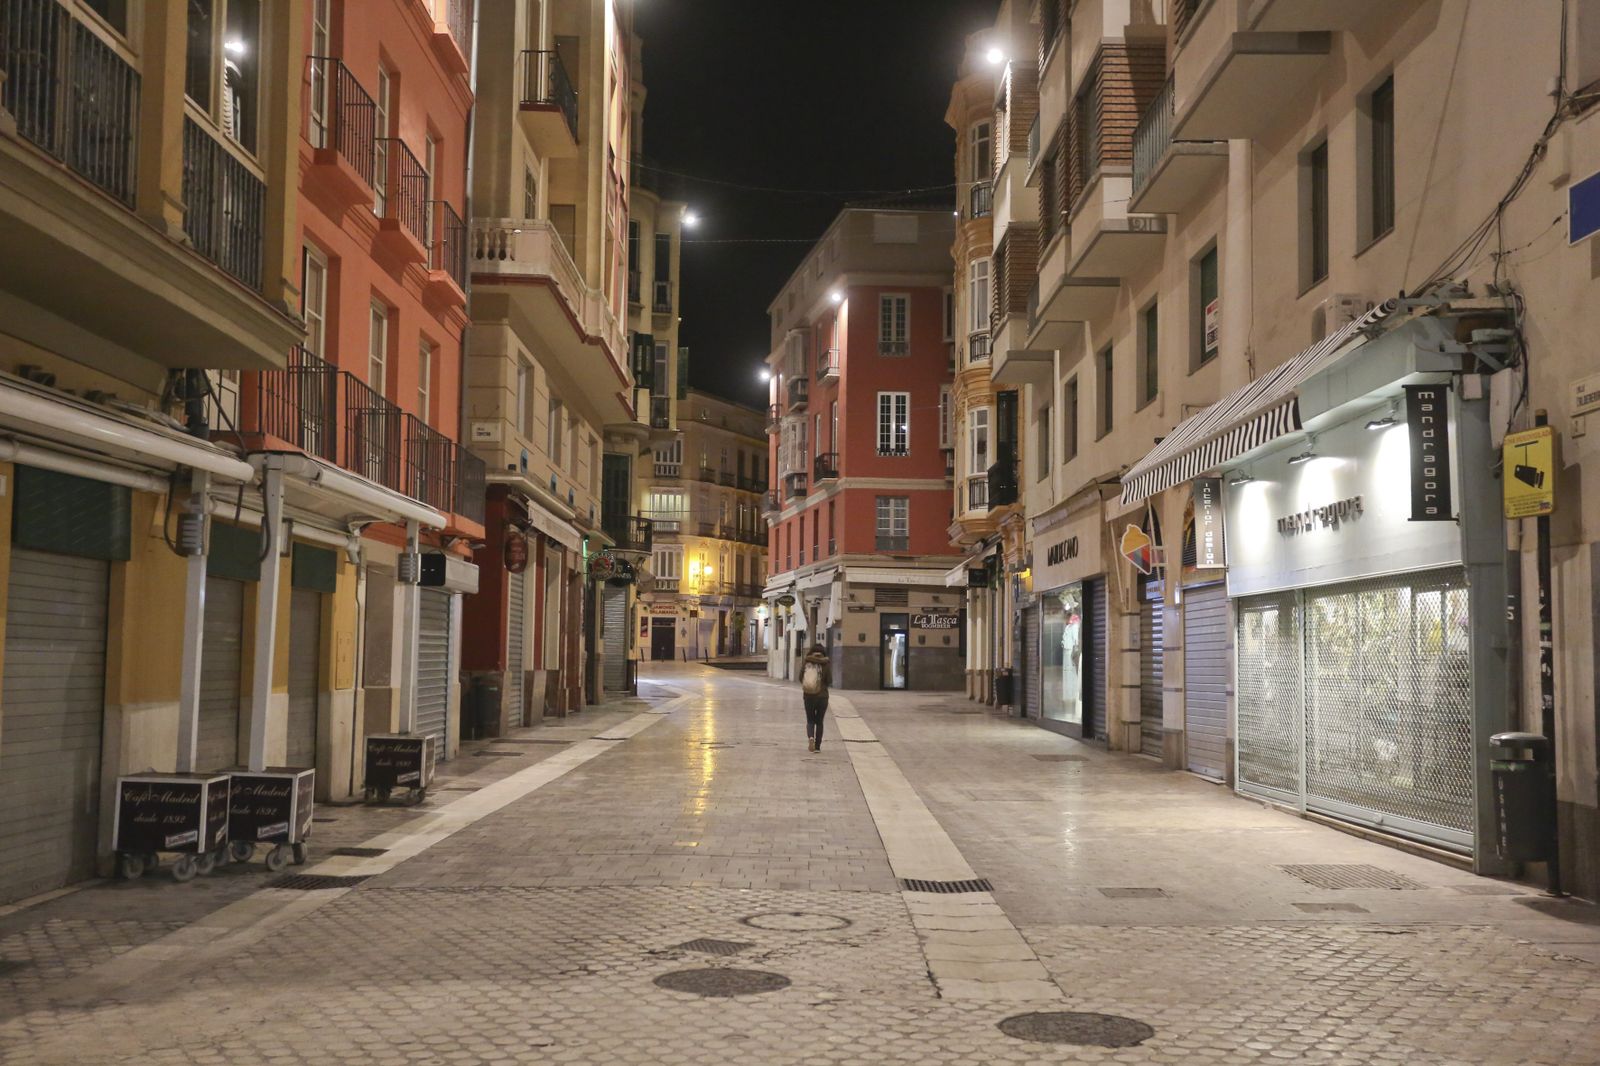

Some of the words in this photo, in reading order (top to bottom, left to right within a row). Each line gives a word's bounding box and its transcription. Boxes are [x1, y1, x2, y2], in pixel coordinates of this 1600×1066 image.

[1418, 391, 1438, 514] mandragora
[1203, 482, 1213, 526] interior
[1278, 495, 1364, 533] mandragora
[1205, 531, 1214, 565] design
[913, 615, 927, 624] La
[928, 614, 957, 625] Tasca
[124, 790, 147, 806] Café
[157, 791, 200, 803] Madrid
[250, 783, 291, 797] Madrid
[163, 815, 186, 824] 1892
[256, 807, 278, 816] 1892
